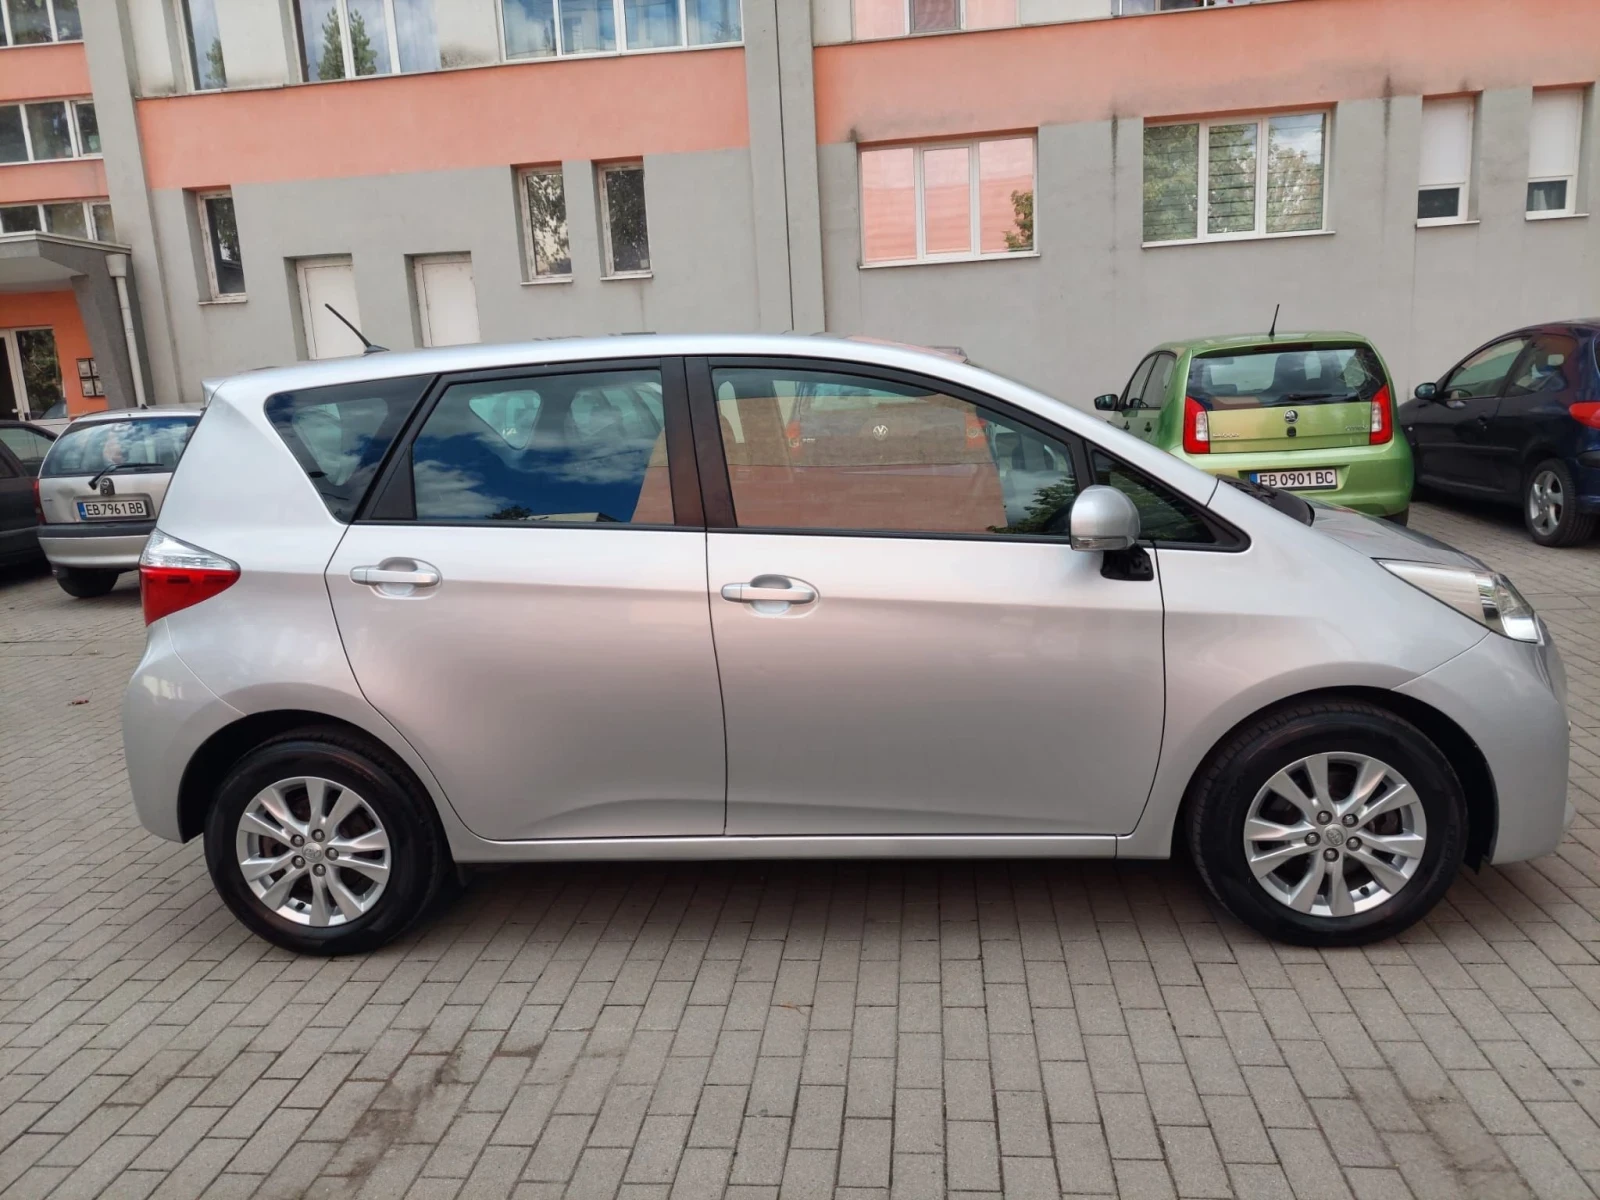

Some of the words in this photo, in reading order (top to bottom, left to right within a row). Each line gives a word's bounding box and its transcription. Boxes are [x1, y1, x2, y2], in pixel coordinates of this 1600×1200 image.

[1260, 475, 1278, 487] EB
[1280, 472, 1313, 486] 0901
[1315, 471, 1334, 485] BC
[85, 503, 101, 516] EB
[101, 503, 127, 516] 7961
[128, 502, 144, 515] BB
